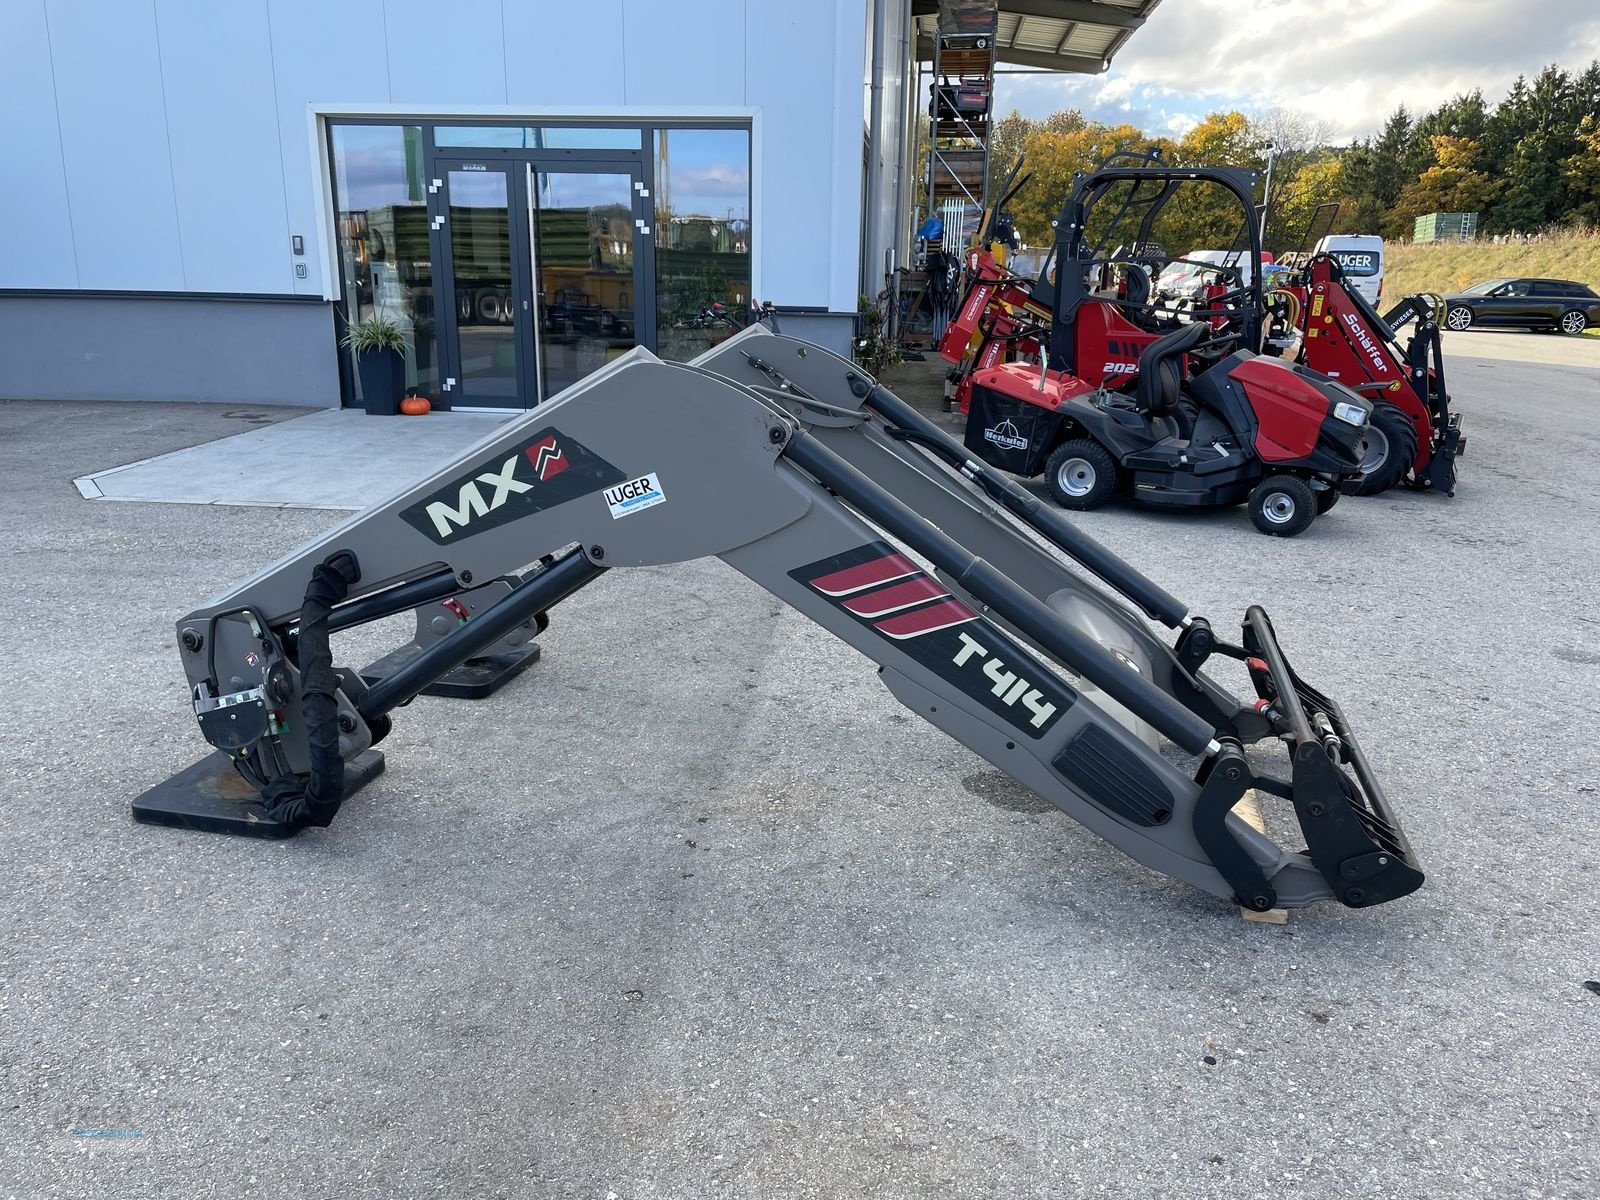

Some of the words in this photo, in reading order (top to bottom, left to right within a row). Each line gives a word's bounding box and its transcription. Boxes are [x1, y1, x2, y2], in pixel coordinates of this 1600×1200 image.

[1335, 254, 1372, 267] UGER
[1342, 313, 1388, 373] Schäffer
[985, 430, 1026, 448] Herkules
[425, 454, 535, 538] MX
[604, 478, 654, 506] LUGER
[952, 631, 989, 668] T
[982, 657, 1057, 729] 414
